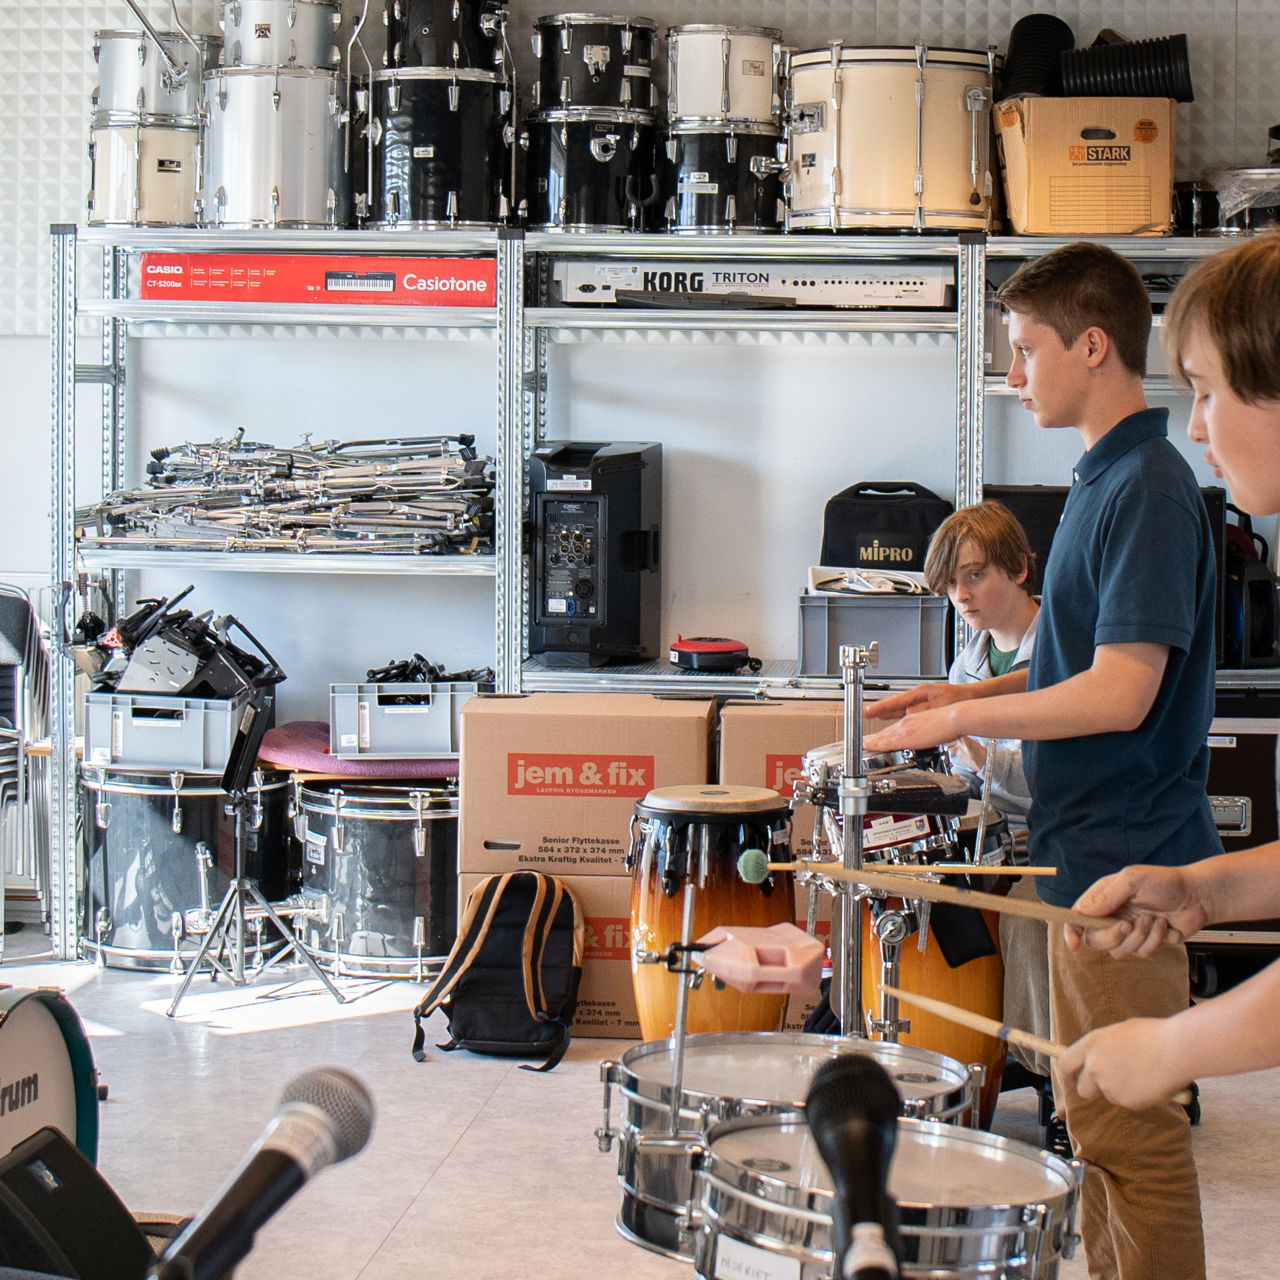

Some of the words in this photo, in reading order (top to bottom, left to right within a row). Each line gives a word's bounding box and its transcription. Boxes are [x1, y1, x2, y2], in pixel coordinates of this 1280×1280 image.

[1088, 147, 1129, 160] STARK
[147, 265, 183, 274] CASIO
[403, 274, 487, 292] Casiotone
[643, 271, 705, 292] KORG
[712, 272, 769, 283] TRITON
[515, 759, 574, 789] jem
[579, 761, 604, 786] &
[608, 761, 647, 786] fix
[773, 761, 802, 791] je
[542, 836, 570, 844] Senior
[572, 837, 620, 845] Flyttekasse
[801, 838, 829, 846] Seor
[564, 846, 581, 854] 372
[518, 855, 546, 863] Ekstra
[548, 856, 577, 864] Kraftig
[580, 856, 613, 864] Kvalitet
